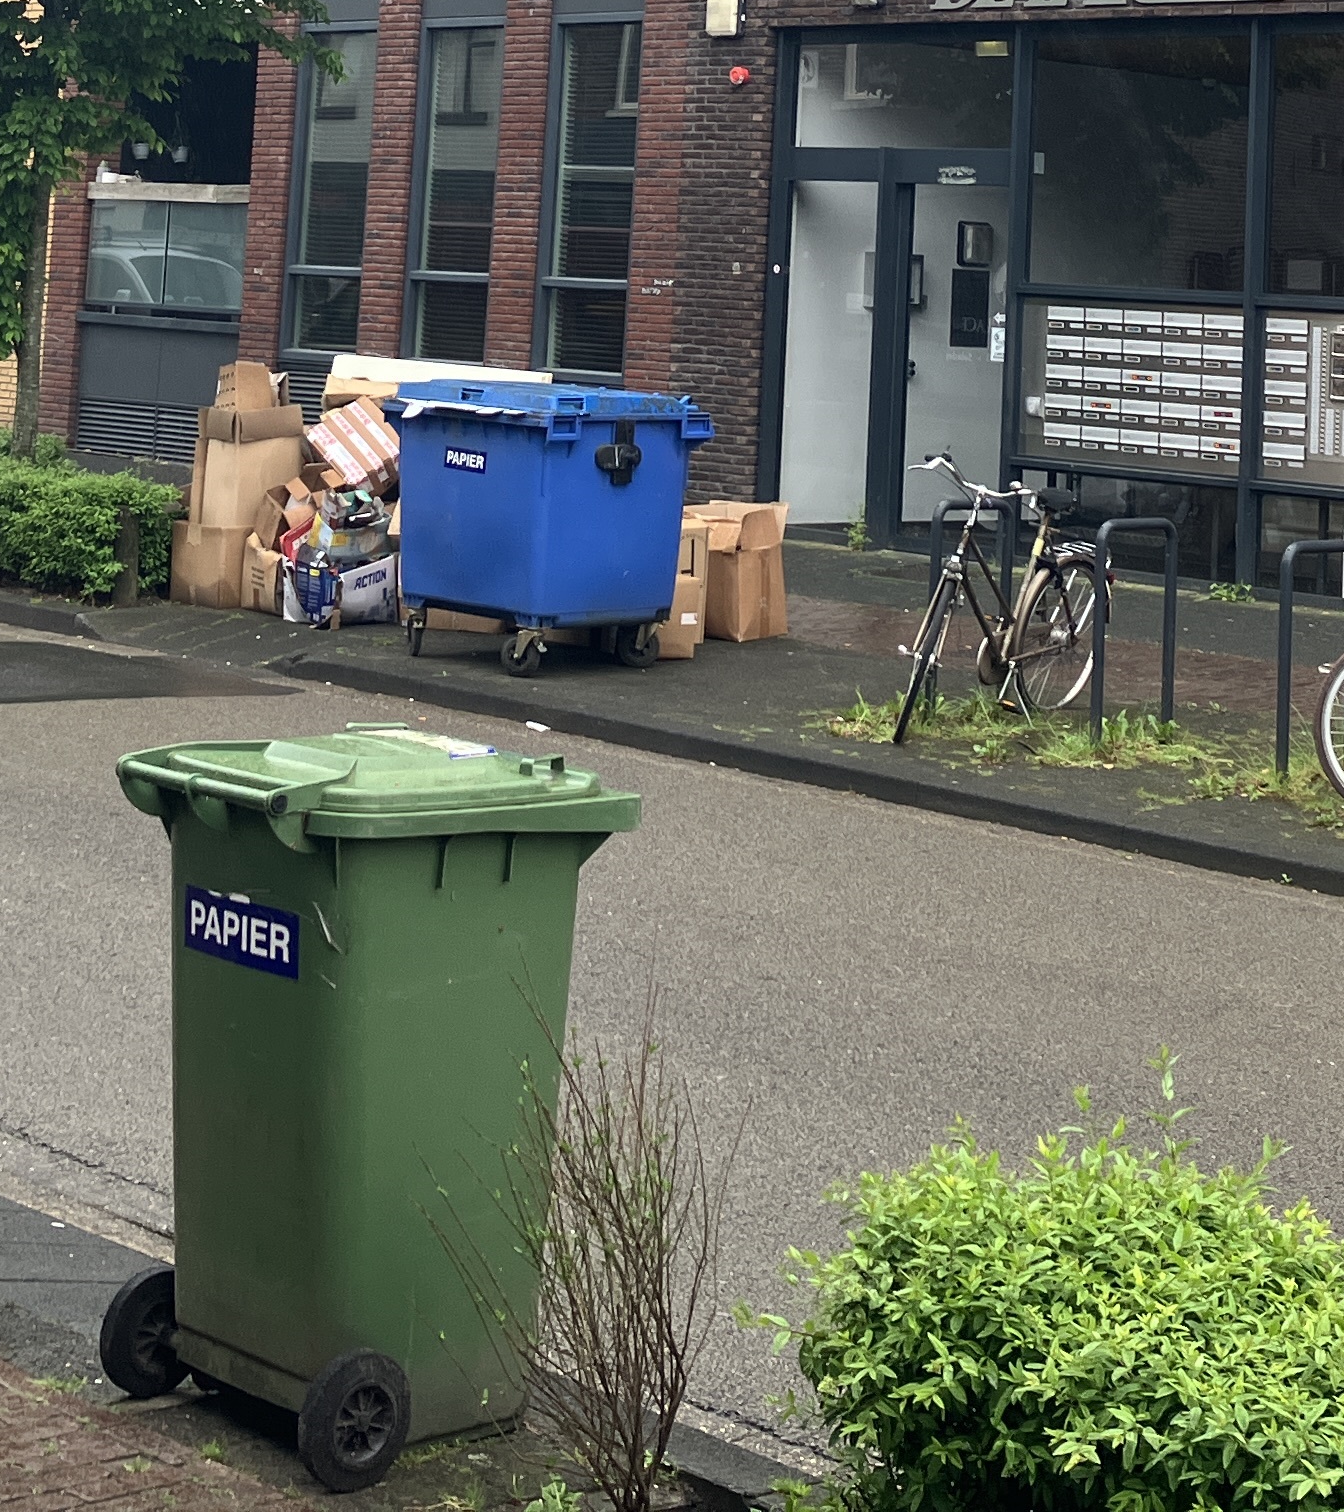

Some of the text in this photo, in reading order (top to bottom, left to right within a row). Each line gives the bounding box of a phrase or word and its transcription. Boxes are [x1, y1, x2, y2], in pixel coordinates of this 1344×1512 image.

[446, 450, 485, 470] PAPIER
[354, 568, 387, 590] ACTION
[190, 899, 290, 964] PAPIER
